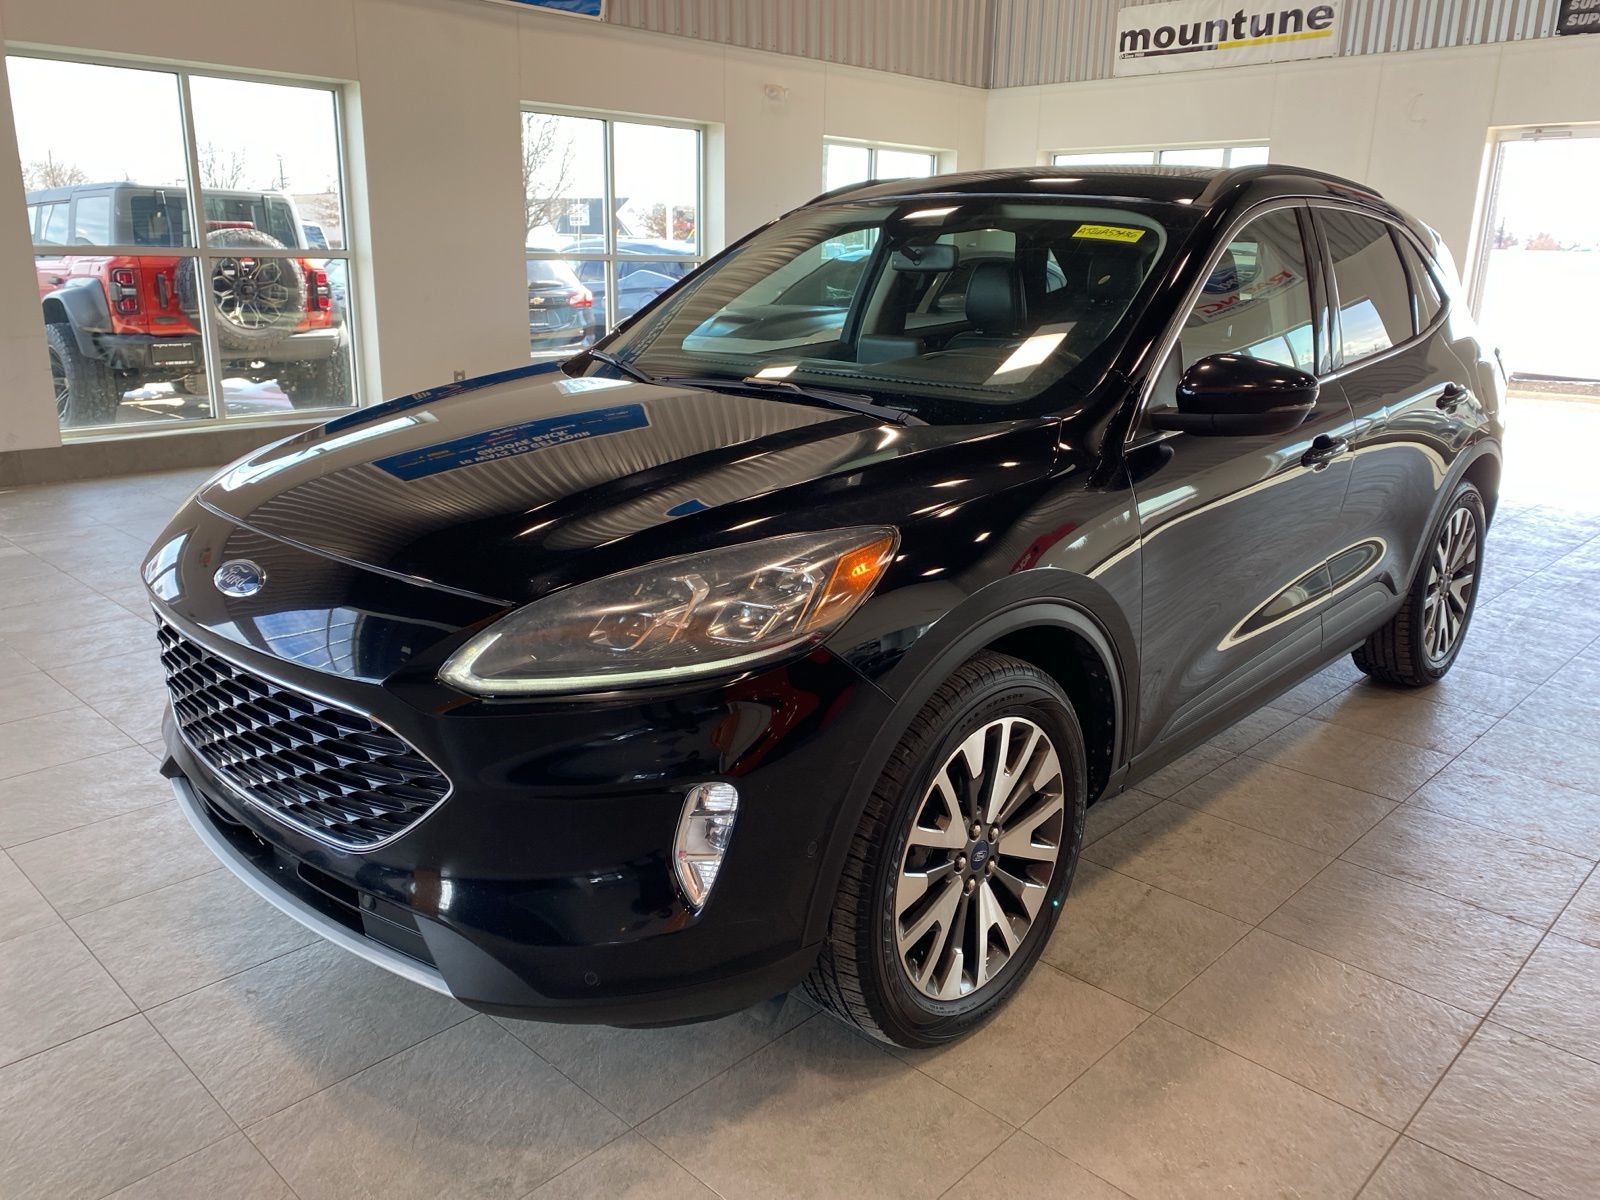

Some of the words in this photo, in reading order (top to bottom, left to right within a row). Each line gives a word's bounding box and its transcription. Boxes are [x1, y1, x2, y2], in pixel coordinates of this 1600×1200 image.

[1119, 5, 1335, 51] mountune
[1566, 12, 1600, 26] SUP
[221, 565, 253, 588] Ford
